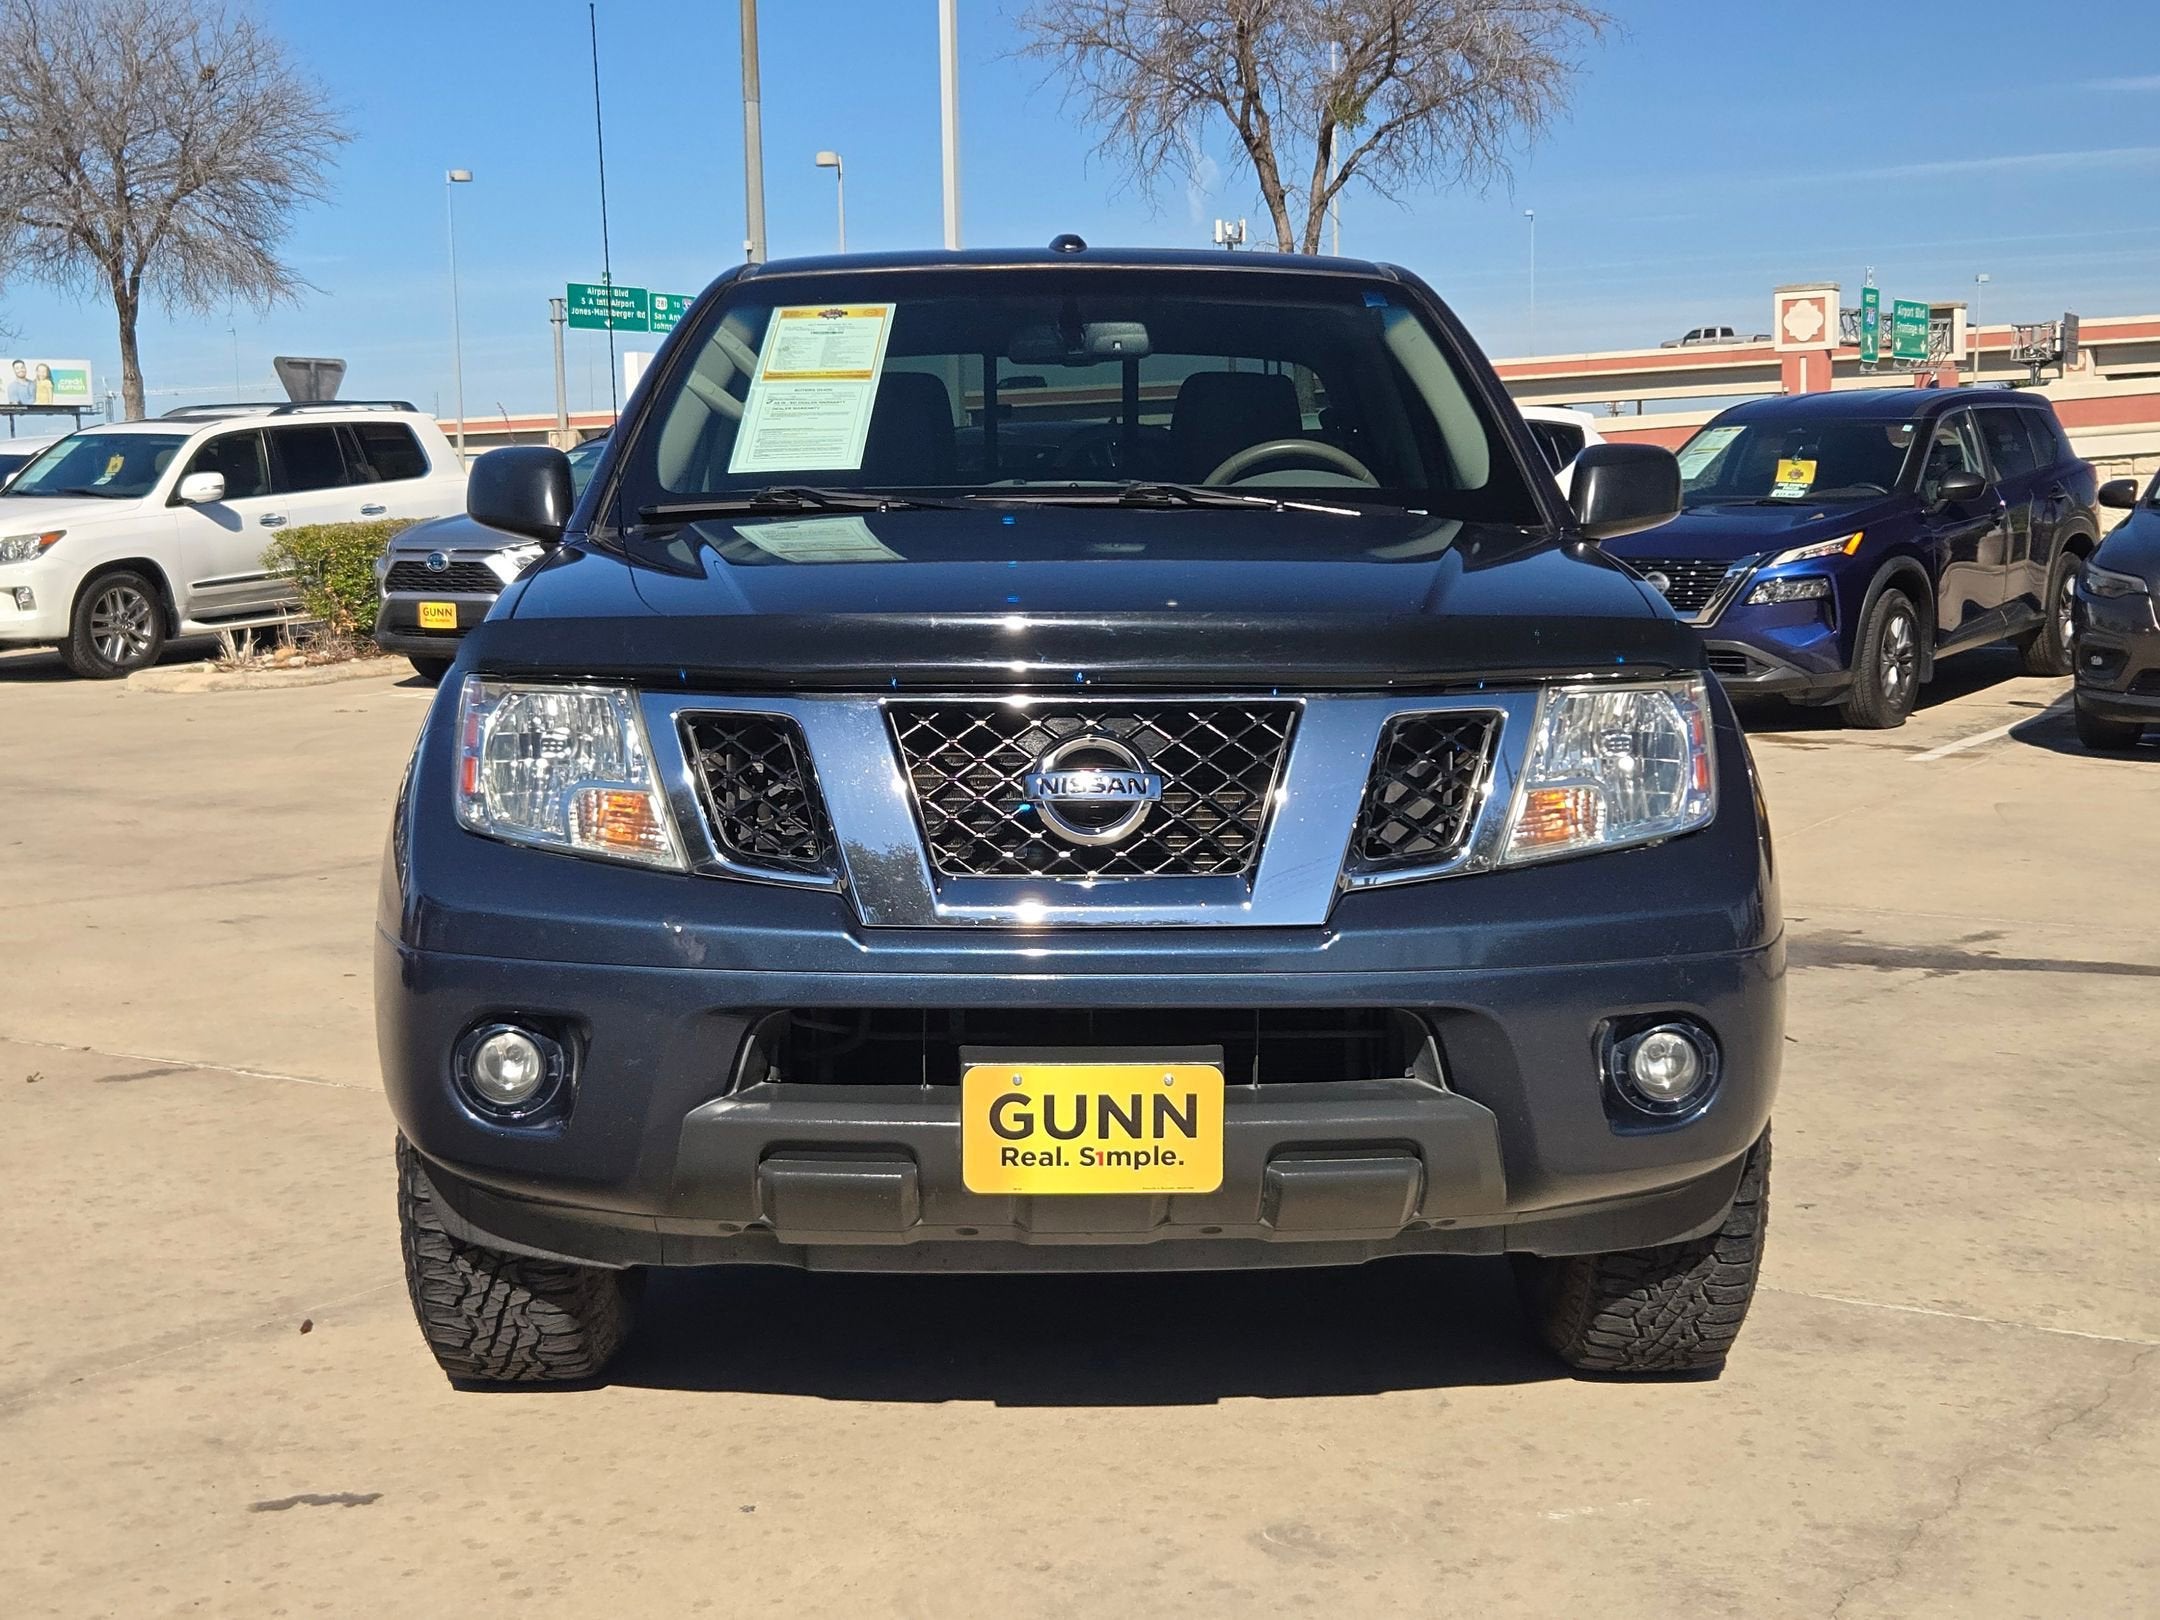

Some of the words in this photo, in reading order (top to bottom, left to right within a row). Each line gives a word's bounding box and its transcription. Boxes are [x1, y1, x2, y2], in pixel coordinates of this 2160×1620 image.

[614, 289, 629, 298] Blvd
[581, 297, 586, 305] S
[611, 299, 635, 309] Airport
[571, 307, 634, 319] Jones-Maltberger
[637, 311, 646, 319] Rd
[654, 312, 667, 321] San
[653, 322, 673, 331] Johns
[423, 607, 453, 617] GUNN
[1036, 774, 1149, 796] NISSAN
[989, 1092, 1198, 1140] GUNN
[1001, 1146, 1070, 1167] Real.
